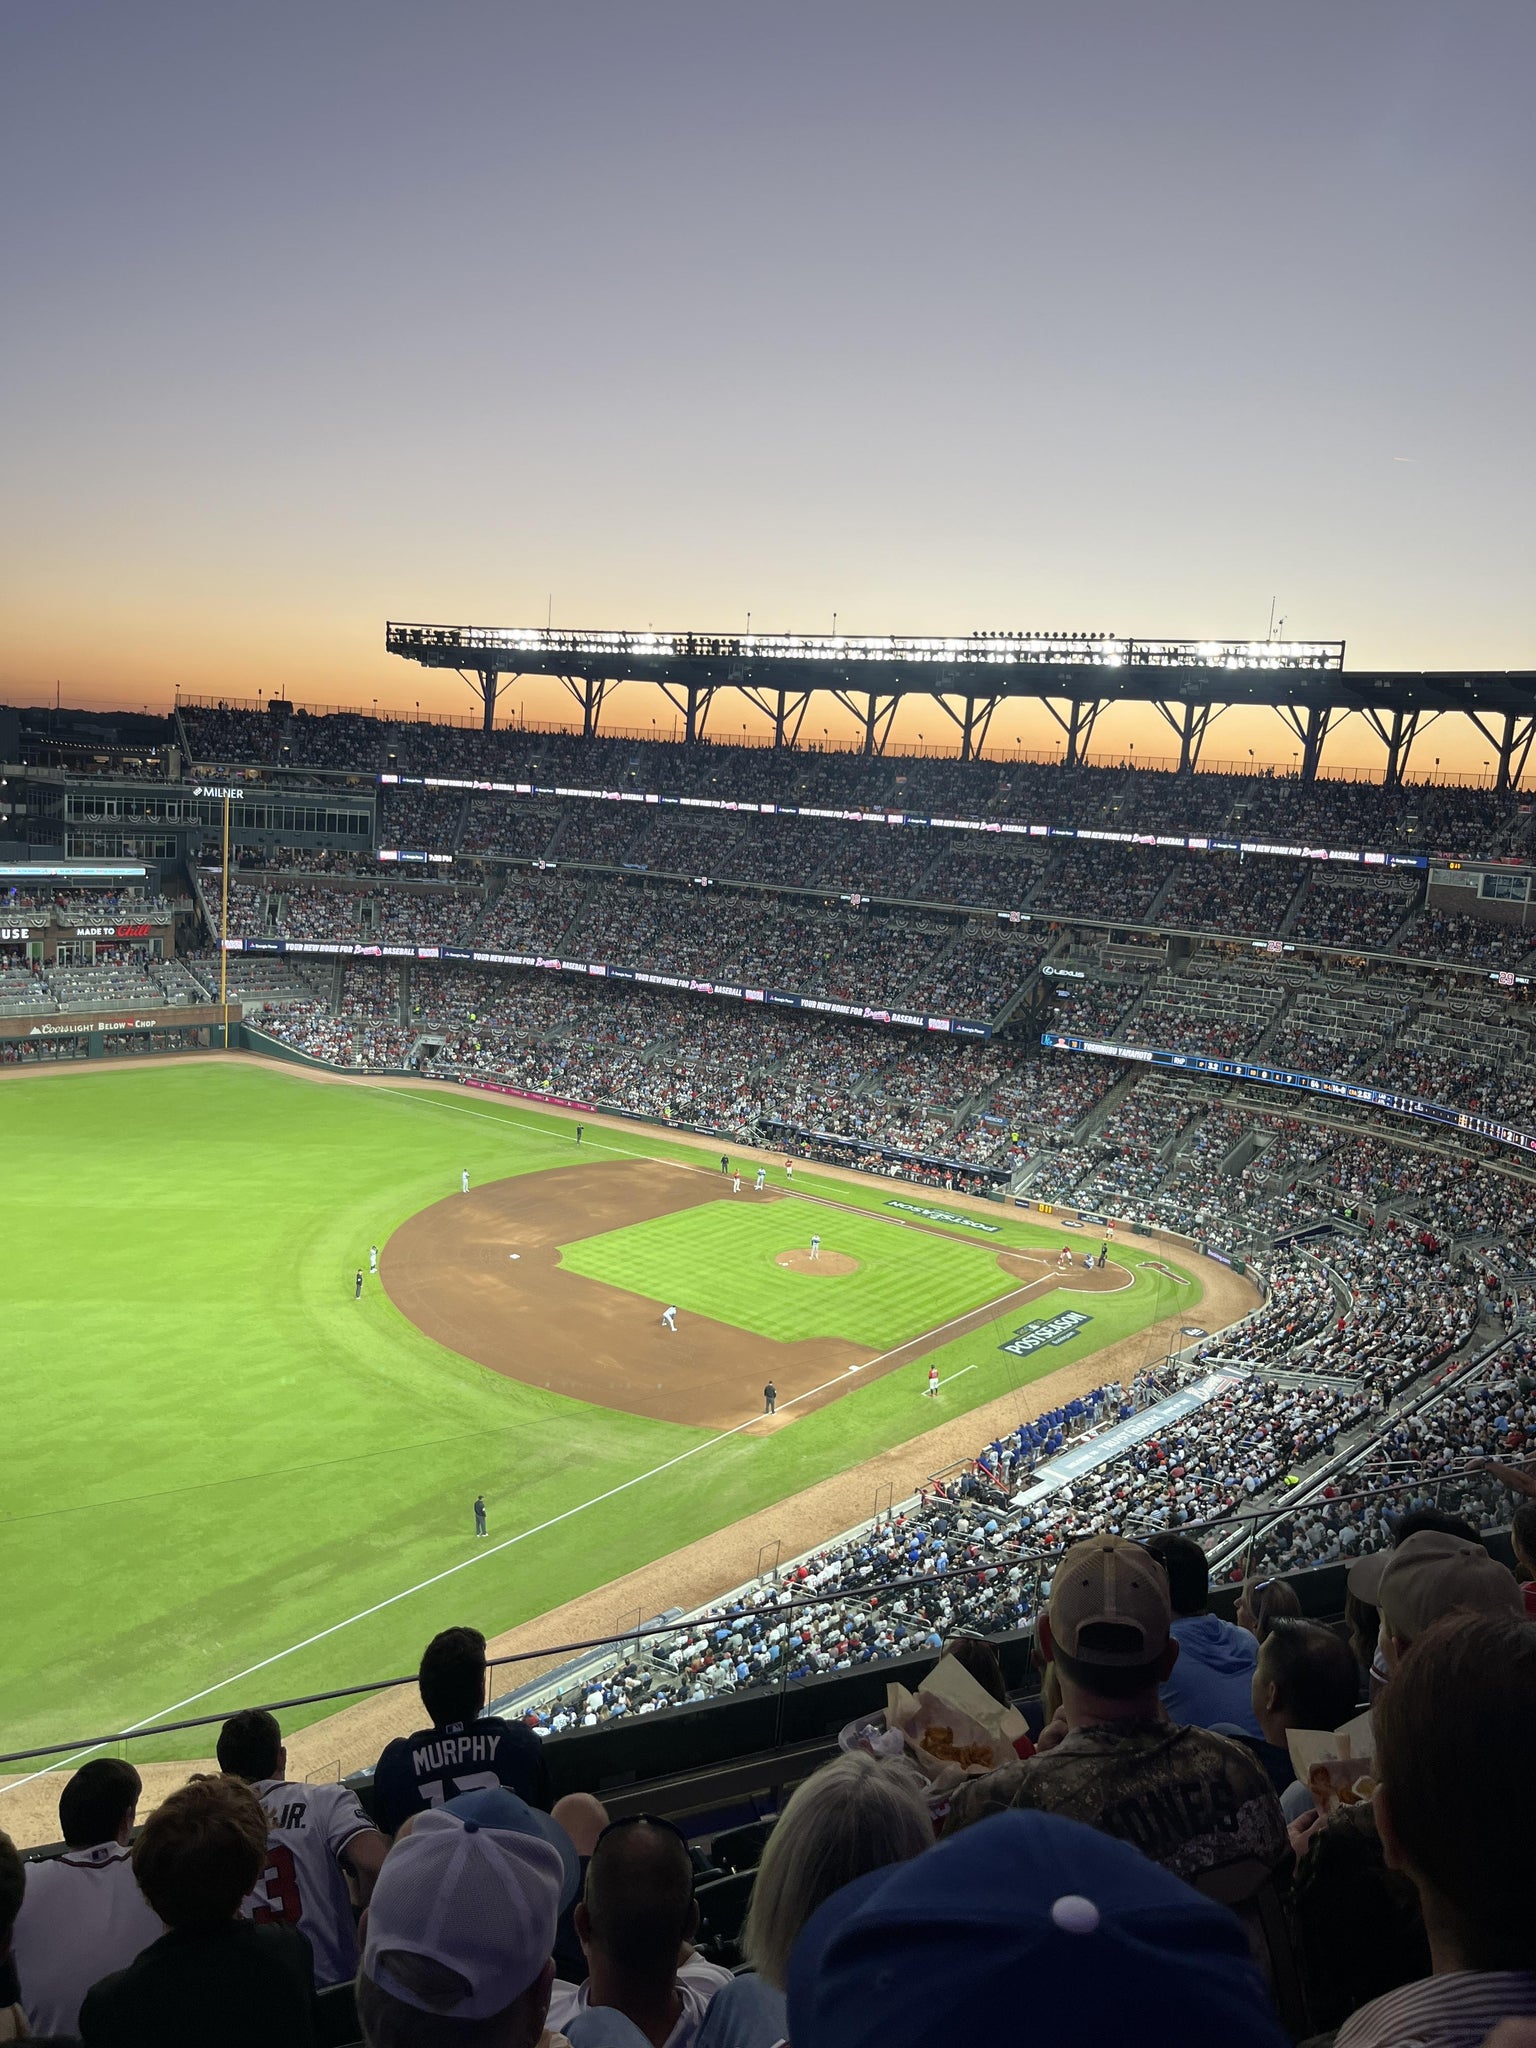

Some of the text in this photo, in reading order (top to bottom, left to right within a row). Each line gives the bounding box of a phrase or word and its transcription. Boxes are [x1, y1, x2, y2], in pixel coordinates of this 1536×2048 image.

[204, 787, 244, 798] MILNER
[1002, 825, 1026, 833] BASEBALL
[1157, 837, 1184, 846] BASEBALL
[1329, 851, 1359, 860] BASEBALL
[540, 861, 545, 869] 3
[2, 929, 29, 939] USE
[116, 925, 151, 937] Chill
[286, 943, 303, 951] YOUR
[383, 947, 414, 955] BASEBALL
[1267, 941, 1283, 952] 25
[474, 953, 489, 961] YOUR
[504, 956, 522, 964] HOME
[523, 957, 535, 965] FOR
[562, 961, 586, 971] BASEBALL
[1054, 969, 1084, 978] LEXUS
[1499, 972, 1514, 985] 29
[649, 975, 662, 983] NEW
[662, 977, 678, 986] HOME
[678, 979, 689, 988] FOR
[715, 985, 742, 996] BASEBALL
[801, 999, 817, 1008] YOUR
[817, 1001, 831, 1010] NEW
[831, 1004, 850, 1014] HOME
[850, 1007, 863, 1016] FOR
[892, 1014, 923, 1025] BASEBALL
[42, 1024, 70, 1034] Coors
[70, 1024, 94, 1032] LIGHT
[1084, 1043, 1117, 1055] YOSHINOBU
[1118, 1048, 1152, 1060] YAMAMOTO
[1208, 1062, 1218, 1070] 3.2
[888, 1200, 998, 1232] POSTSEASON
[1004, 1312, 1087, 1354] POSTSEASON
[1143, 1414, 1163, 1432] PARK
[413, 1735, 500, 1776] MURPHY
[280, 1803, 306, 1829] JR.
